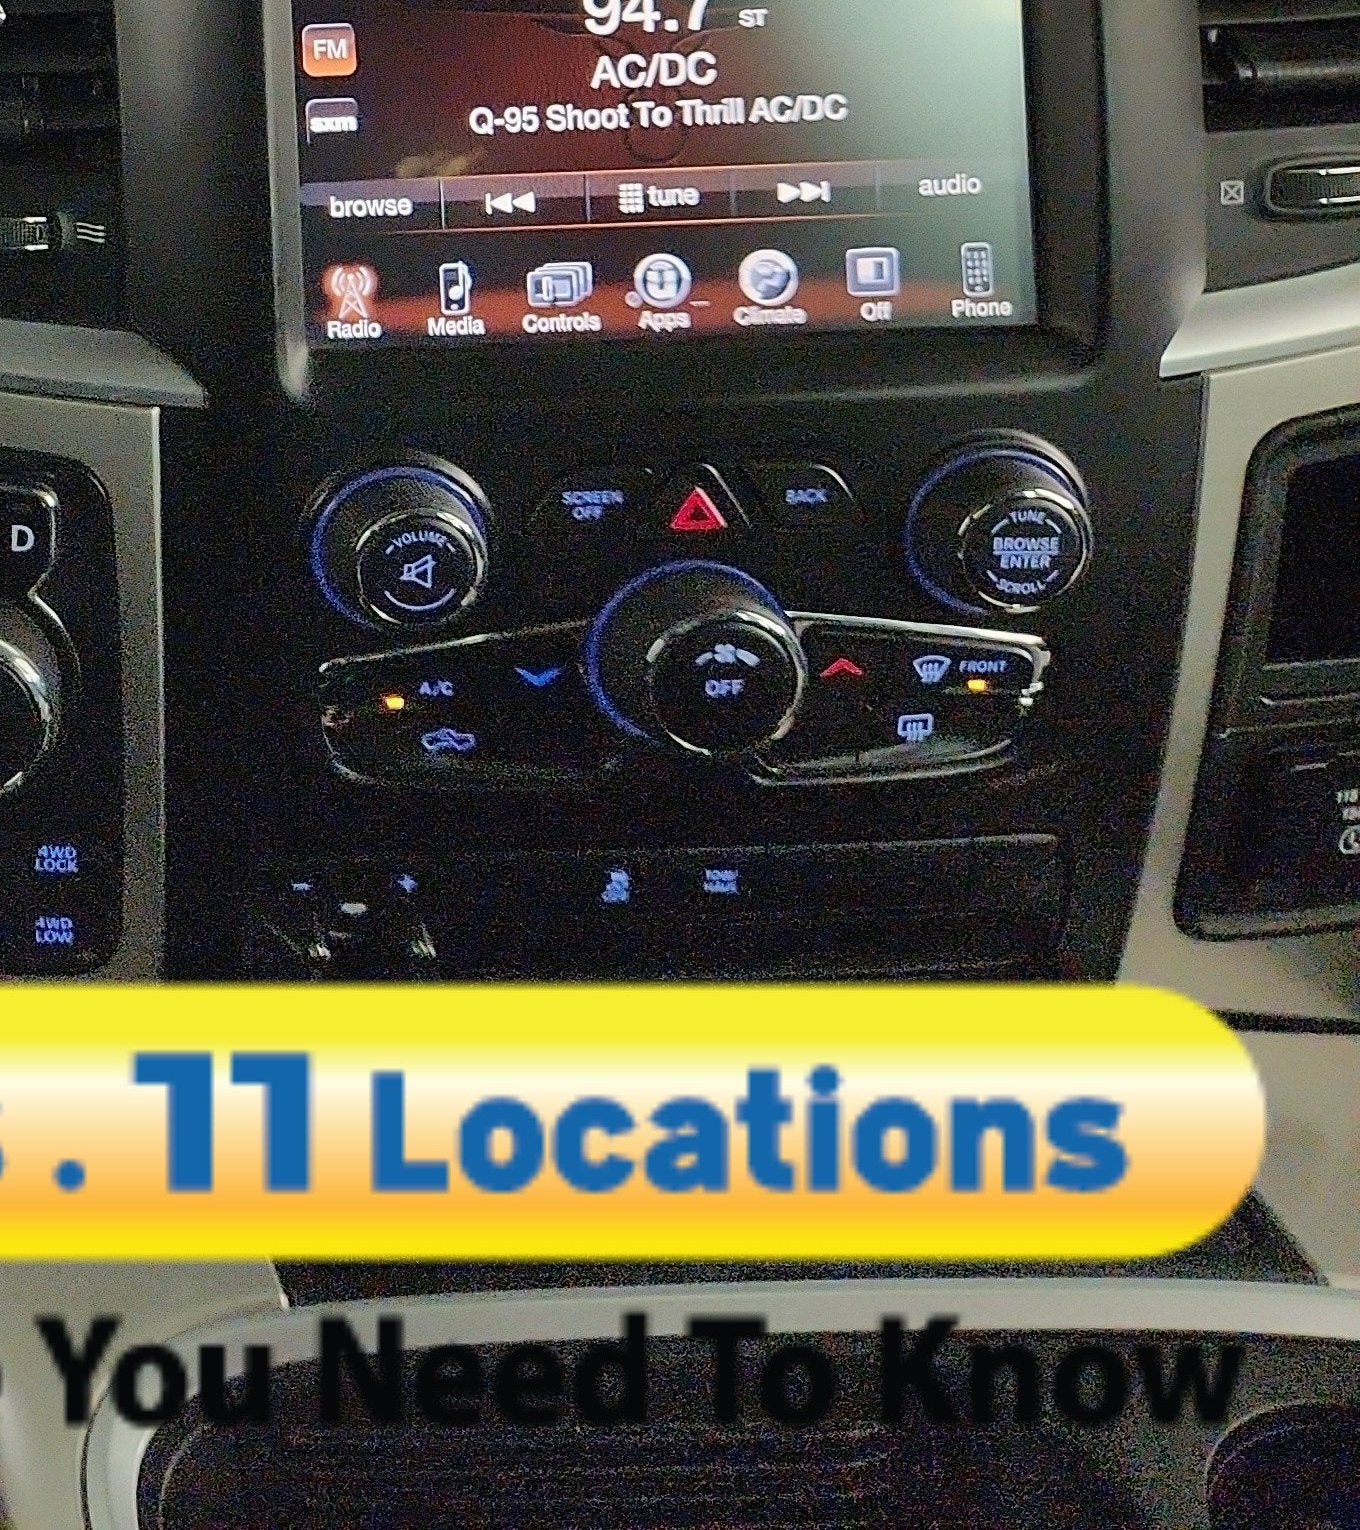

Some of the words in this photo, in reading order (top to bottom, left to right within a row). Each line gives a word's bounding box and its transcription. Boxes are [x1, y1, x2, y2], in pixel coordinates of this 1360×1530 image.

[739, 8, 769, 27] ST
[313, 38, 348, 60] FM
[591, 50, 717, 89] AC/DC
[469, 106, 538, 135] Q-95
[546, 103, 629, 132] Shoot
[632, 101, 672, 128] To
[675, 98, 745, 126] Thrill
[749, 94, 850, 122] AC/DC
[919, 173, 982, 197] audio
[647, 185, 700, 207] tune
[330, 195, 413, 218] browse
[733, 305, 807, 326] Climate
[860, 301, 893, 321] Off
[951, 298, 1012, 320] Phone
[327, 320, 382, 339] Radio
[428, 317, 485, 337] Media
[522, 312, 602, 333] Controls
[637, 310, 692, 333] Apps
[1009, 509, 1047, 526] TUNE
[11, 525, 35, 552] D
[391, 530, 449, 549] VOLUME
[993, 536, 1060, 551] BROWSE
[999, 553, 1052, 569] ENTER
[959, 660, 1007, 674] FRONT
[419, 679, 454, 697] A/C
[705, 679, 745, 697] OFF
[38, 844, 77, 859] 4WD
[35, 857, 79, 873] LOCK
[35, 930, 73, 945] LOW
